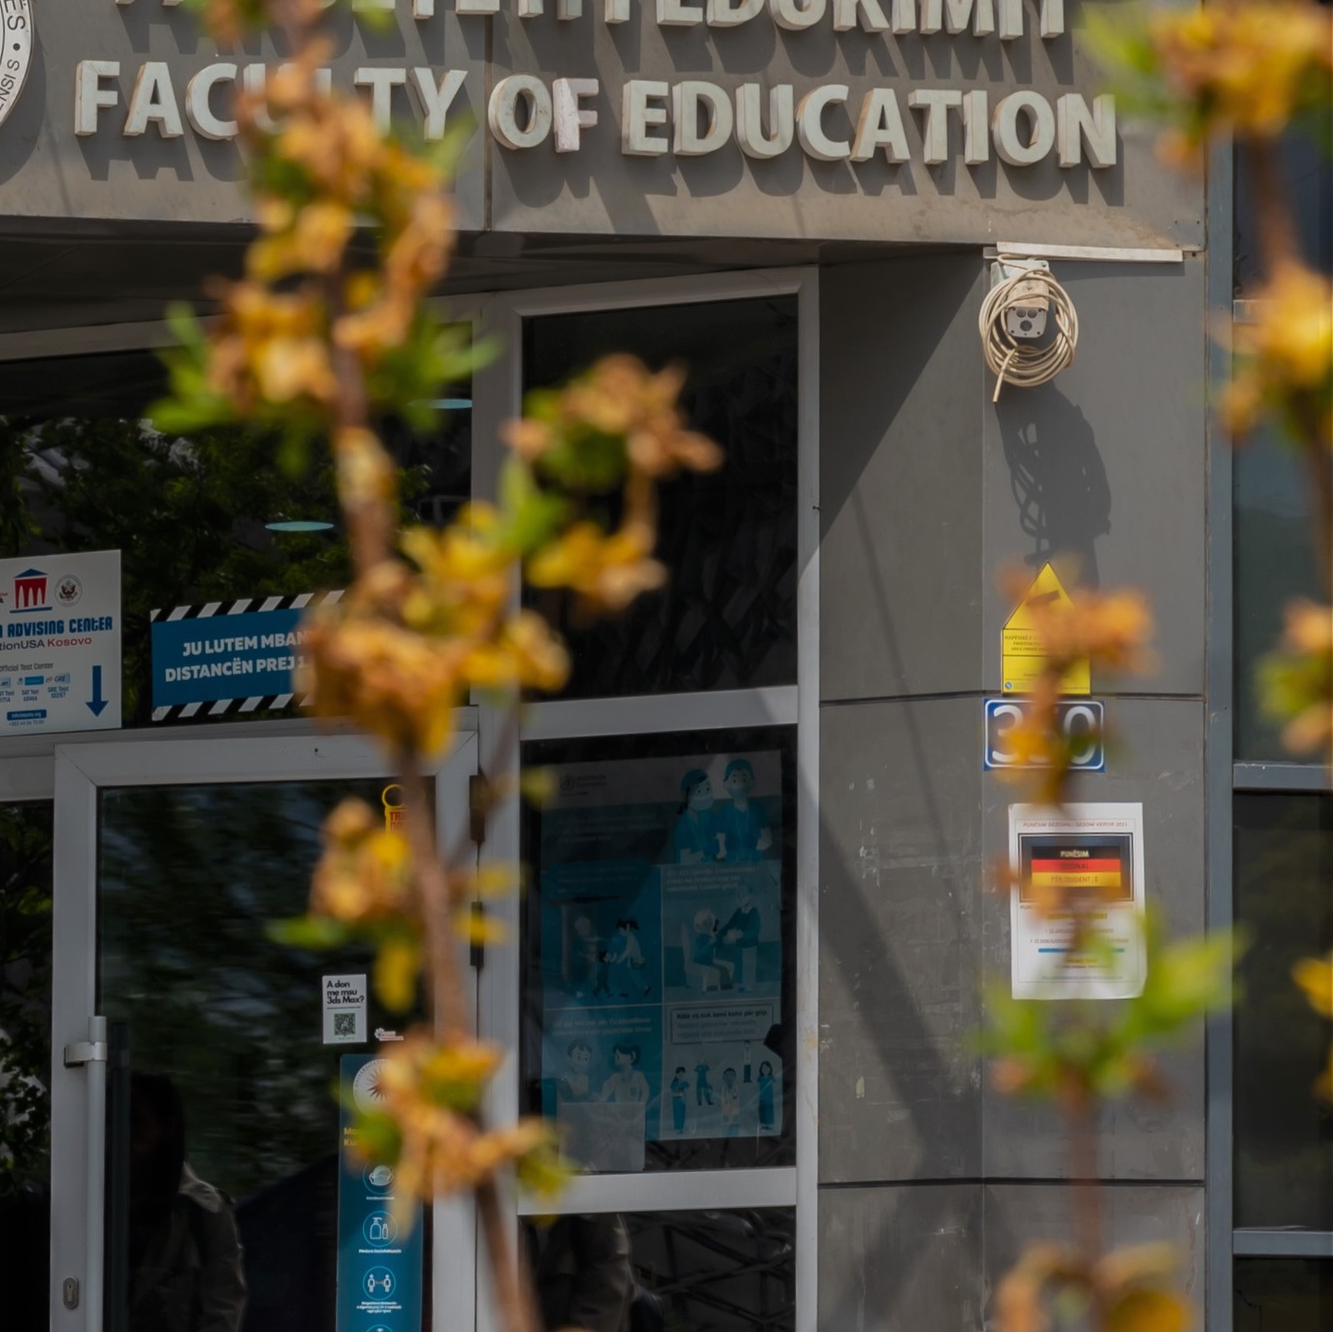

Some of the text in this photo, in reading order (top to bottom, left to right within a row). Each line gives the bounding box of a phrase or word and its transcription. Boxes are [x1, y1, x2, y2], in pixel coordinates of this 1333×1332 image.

[488, 73, 598, 153] OF
[621, 79, 1117, 169] EDUCATION
[7, 619, 65, 638] ADVISING
[47, 636, 93, 648] Kosovo
[182, 641, 203, 657] JU
[204, 635, 258, 655] LUTEM
[20, 663, 33, 671] Test
[33, 662, 54, 670] Center
[164, 657, 254, 683] DISTANCËN
[256, 655, 295, 673] PREJ
[992, 704, 1097, 765] 30
[326, 979, 351, 988] A don
[326, 995, 365, 1004] 3ds Max?
